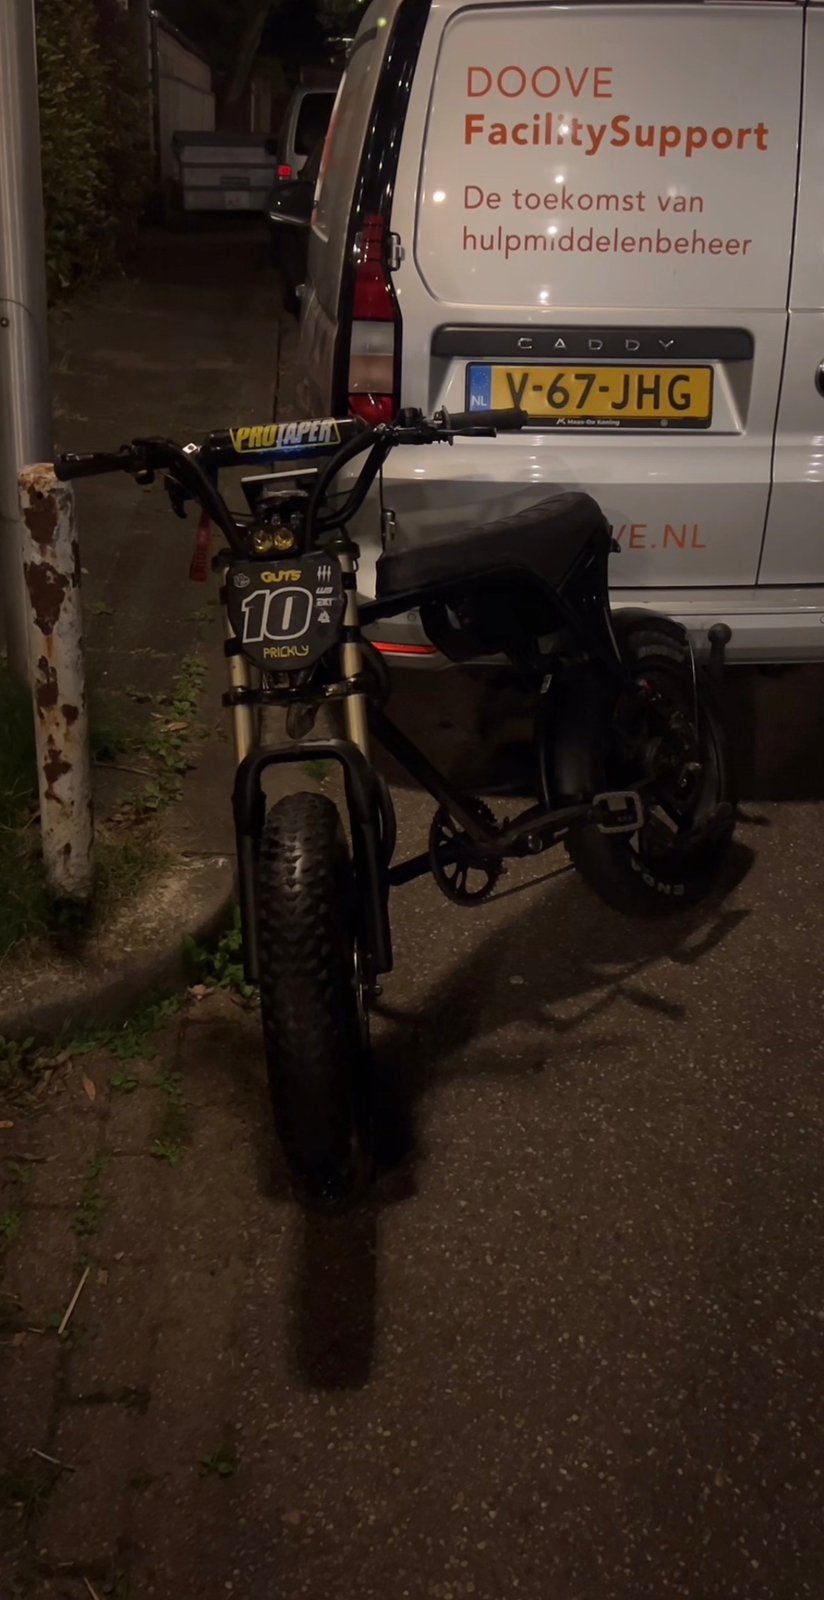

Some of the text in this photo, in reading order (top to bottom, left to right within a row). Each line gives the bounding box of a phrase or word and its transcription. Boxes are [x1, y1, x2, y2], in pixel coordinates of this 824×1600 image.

[467, 66, 613, 98] DOOVE
[464, 113, 769, 157] FacilitySupport
[463, 185, 704, 213] De toekomst van
[462, 225, 753, 259] hulpmiddelenbeheer
[517, 337, 674, 349] CADDY
[471, 395, 487, 407] NL
[506, 373, 691, 411] V-67-JHG
[260, 569, 302, 584] GUTS
[241, 586, 314, 644] 10
[262, 644, 310, 659] PRICKLY
